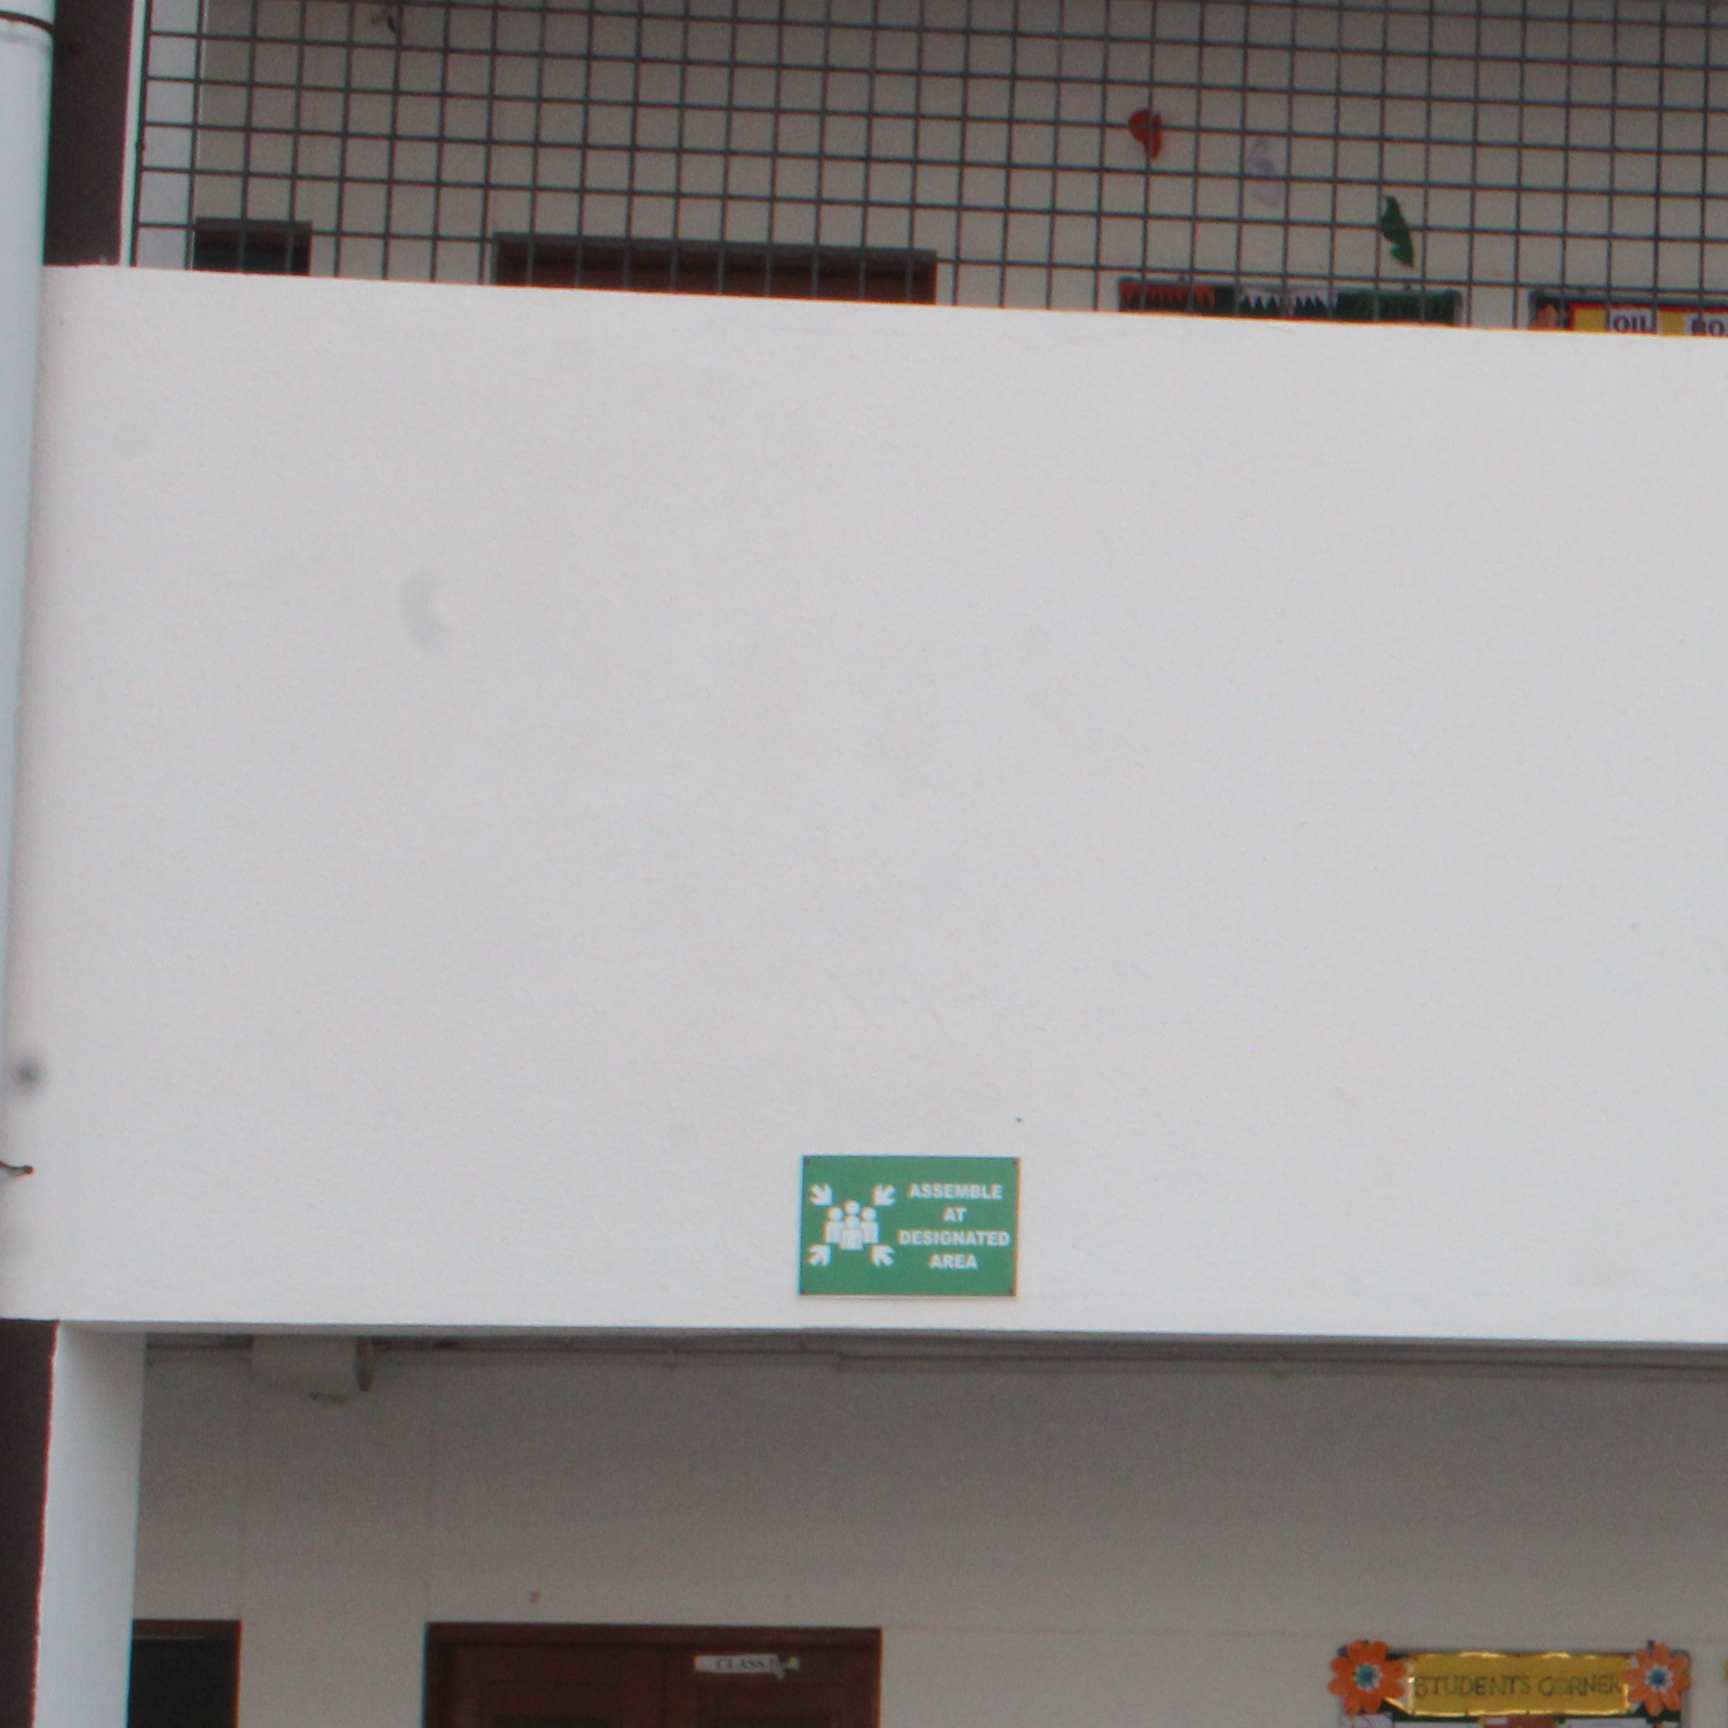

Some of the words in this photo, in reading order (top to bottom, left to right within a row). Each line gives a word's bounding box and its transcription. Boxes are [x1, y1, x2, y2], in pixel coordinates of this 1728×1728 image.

[1612, 315, 1647, 334] OIL
[907, 1183, 1003, 1200] ASSEMBLE
[942, 1207, 967, 1223] AT
[898, 1230, 1011, 1246] DESIGNATED
[929, 1254, 978, 1270] AREA
